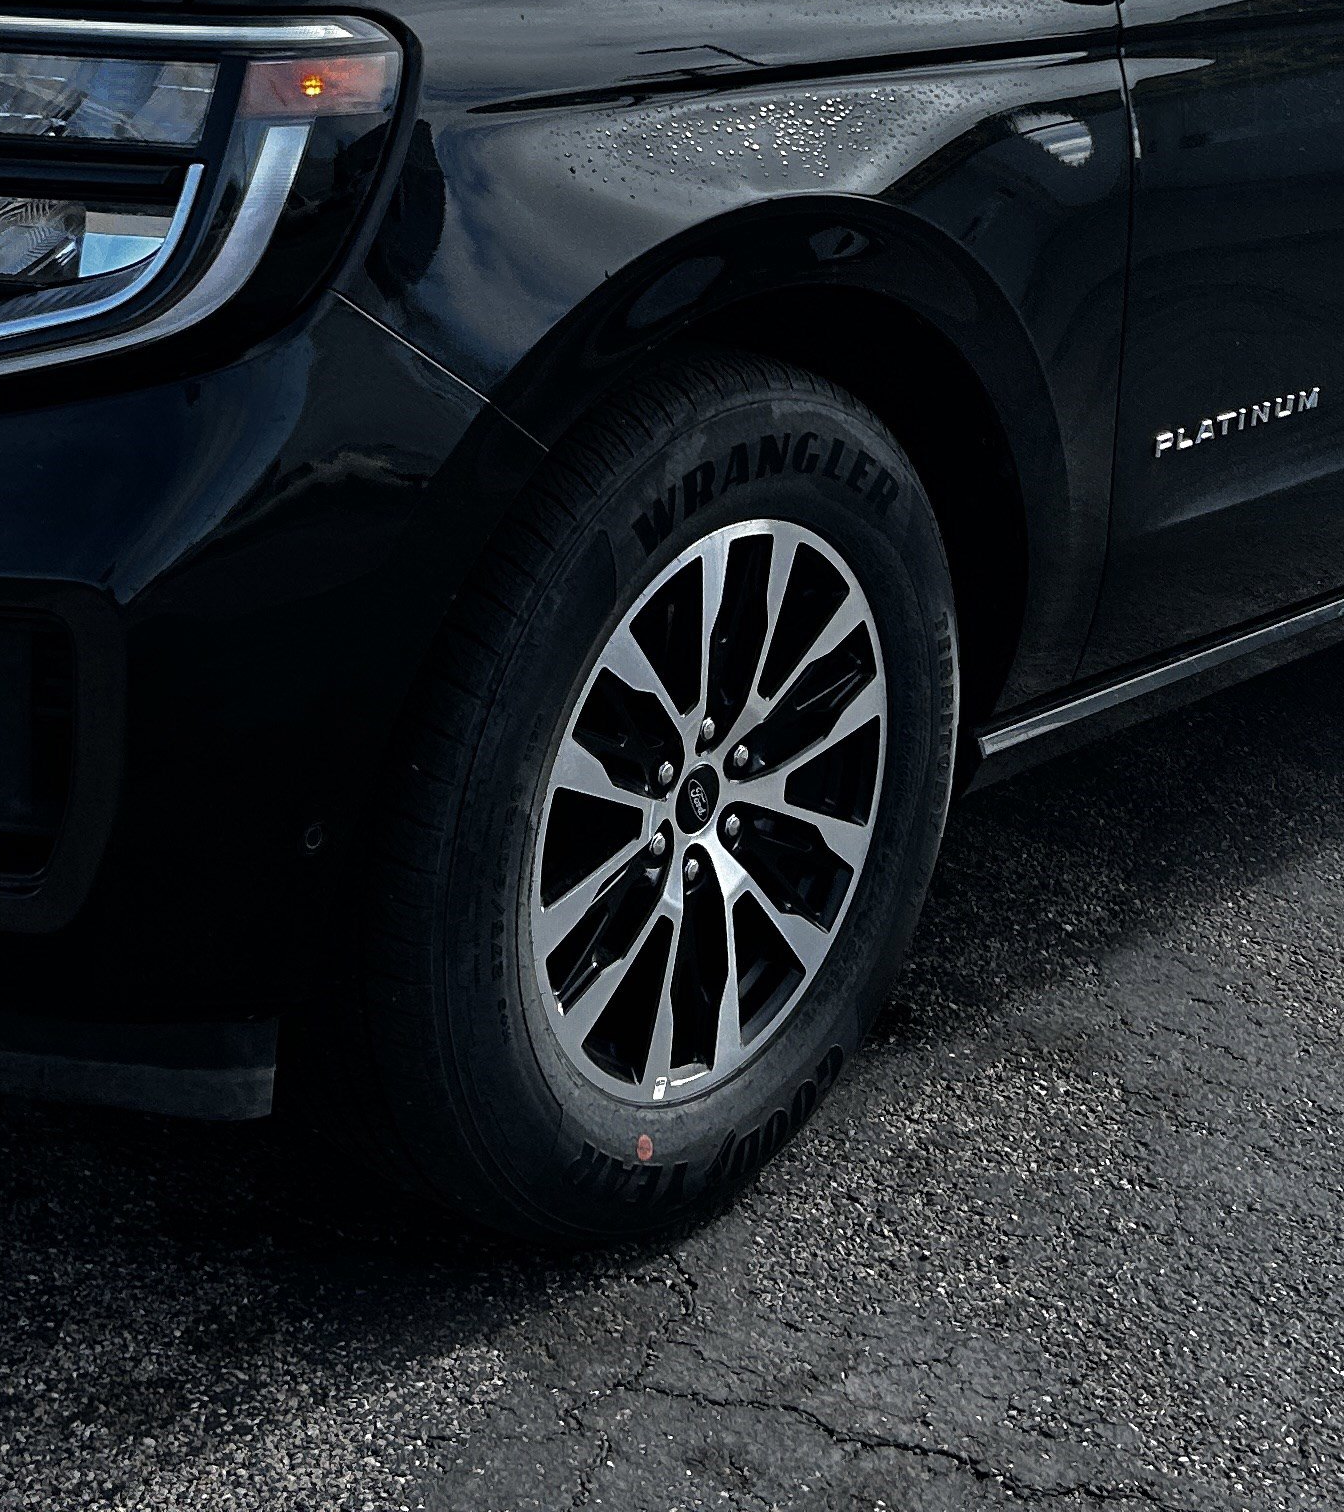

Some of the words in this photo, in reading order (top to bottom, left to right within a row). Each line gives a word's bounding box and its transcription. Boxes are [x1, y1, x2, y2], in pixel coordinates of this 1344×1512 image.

[1154, 386, 1321, 458] PLATINUM
[632, 431, 900, 557] WRANGLER
[690, 786, 707, 816] Ford
